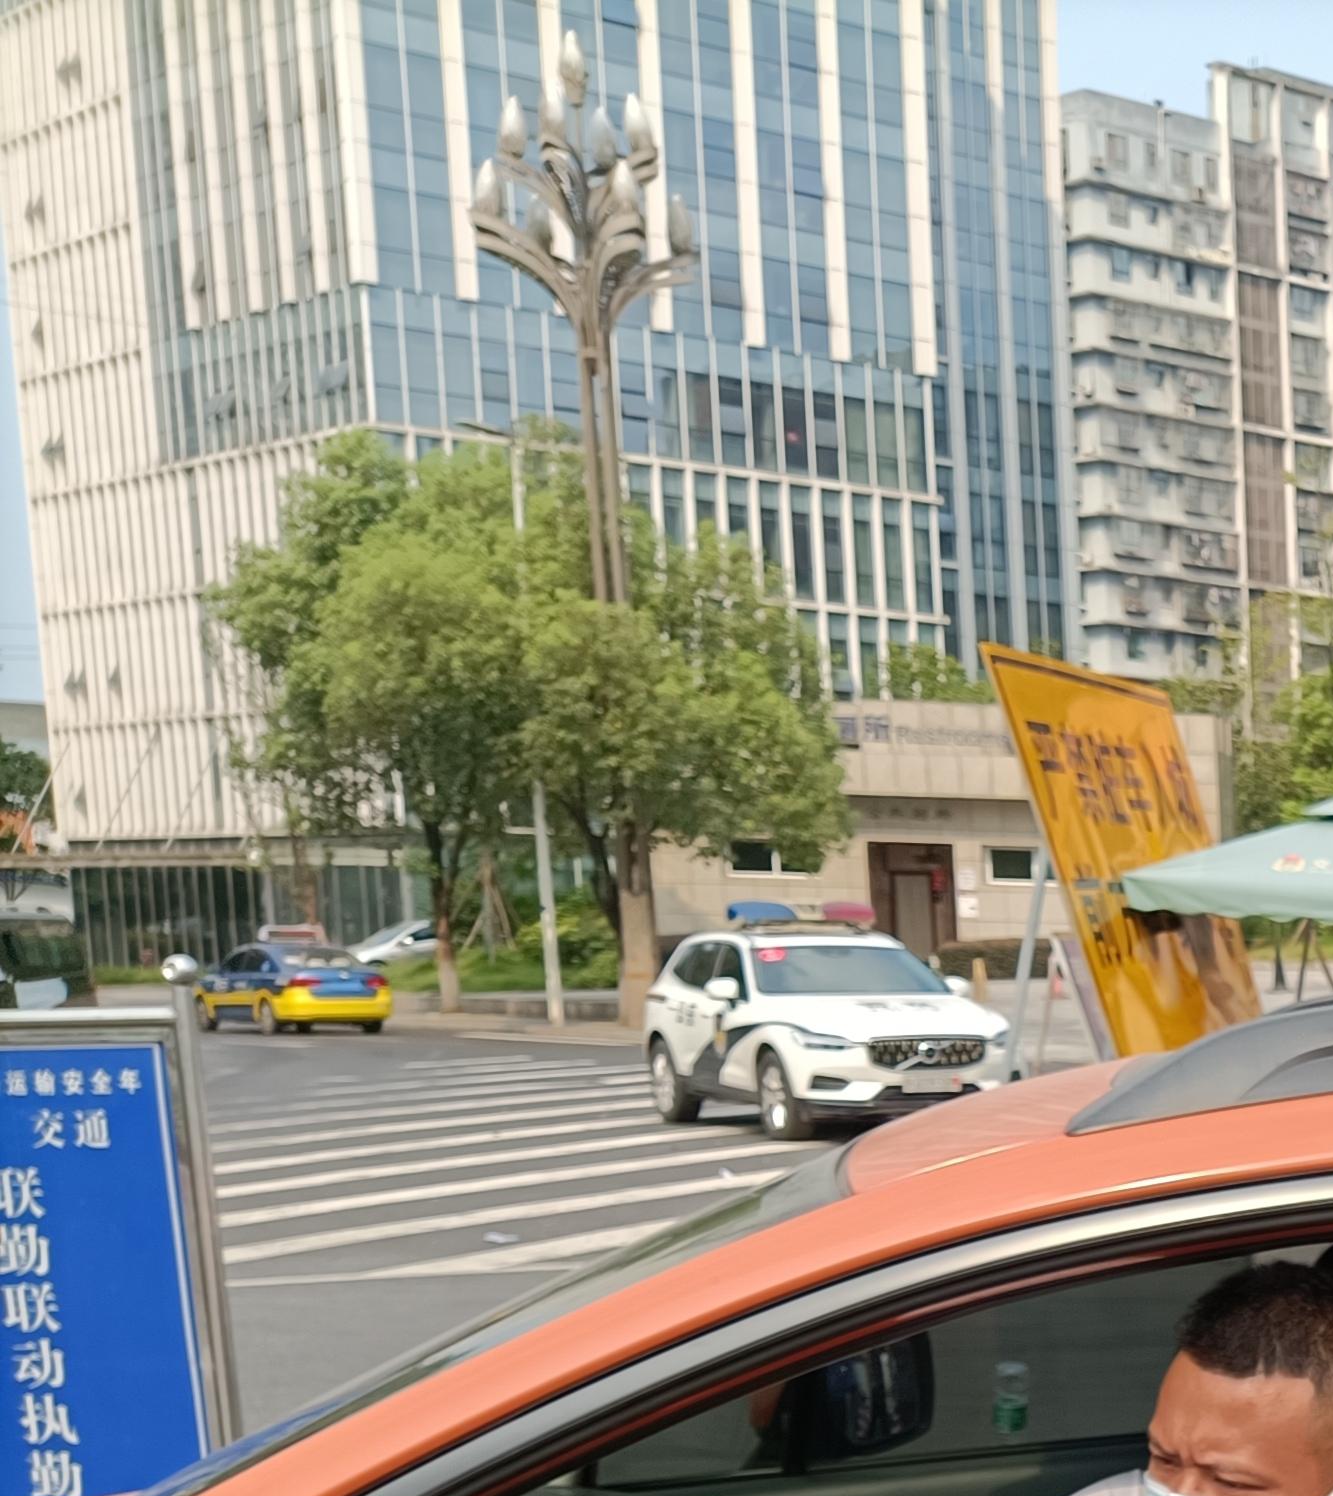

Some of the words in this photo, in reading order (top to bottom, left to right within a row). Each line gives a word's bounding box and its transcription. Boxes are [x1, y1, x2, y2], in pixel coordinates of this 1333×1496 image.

[5, 1067, 142, 1096] 运输安全年
[33, 1107, 111, 1149] 交通
